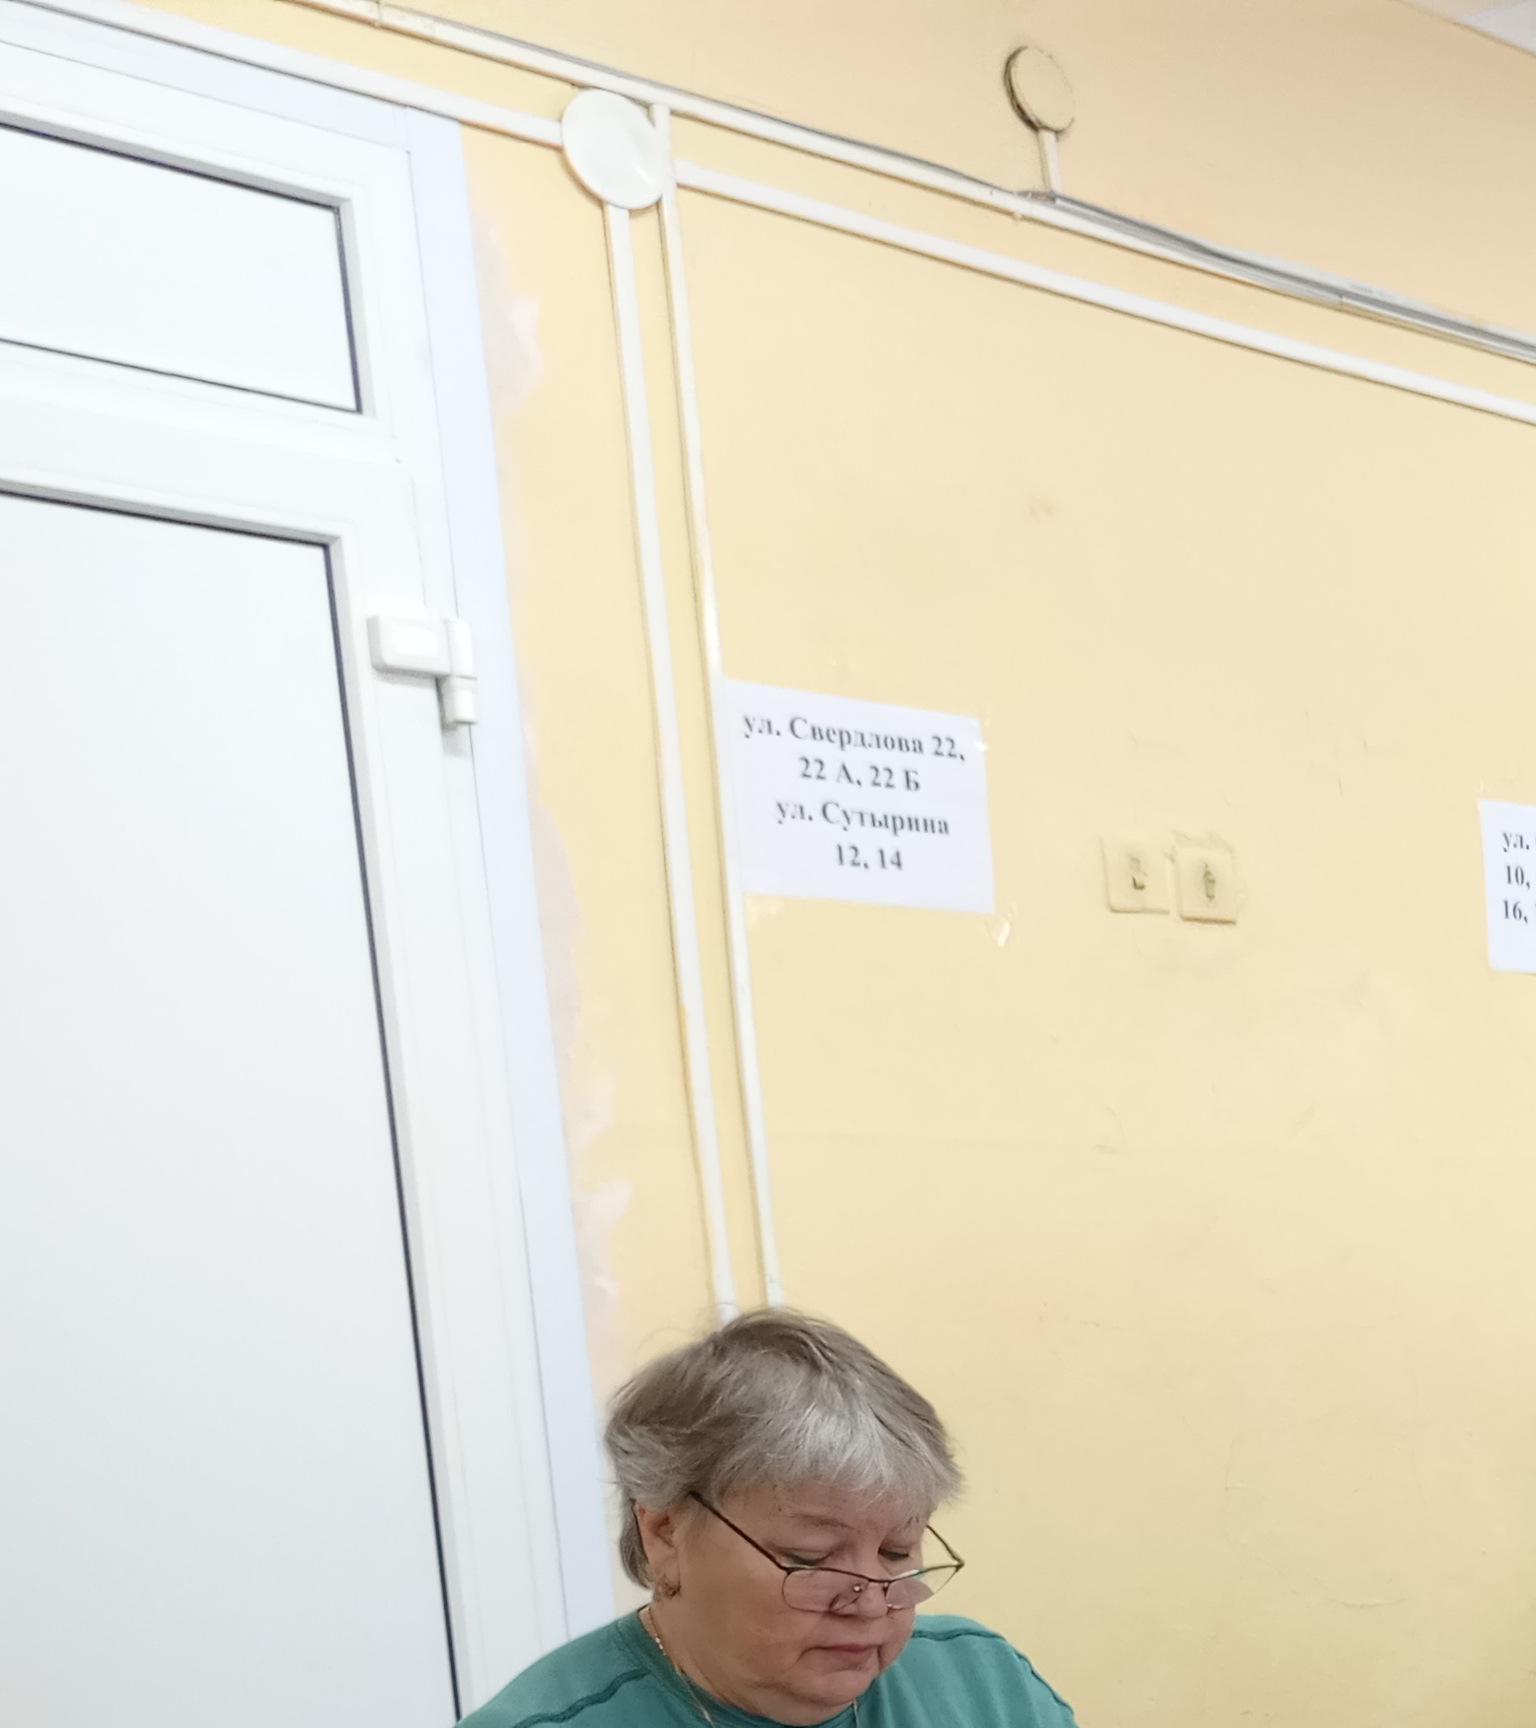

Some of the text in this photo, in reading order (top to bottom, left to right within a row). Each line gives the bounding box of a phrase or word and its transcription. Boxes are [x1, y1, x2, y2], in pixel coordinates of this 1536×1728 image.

[742, 713, 965, 762] ул. Свердлова 22,
[799, 756, 921, 793] 22 А, 22 Б
[774, 797, 950, 836] ул. Сутырина
[1502, 830, 1531, 853] ул.
[836, 842, 904, 871] 12, 14
[1505, 865, 1531, 890] 10,
[1502, 898, 1529, 925] 16,
